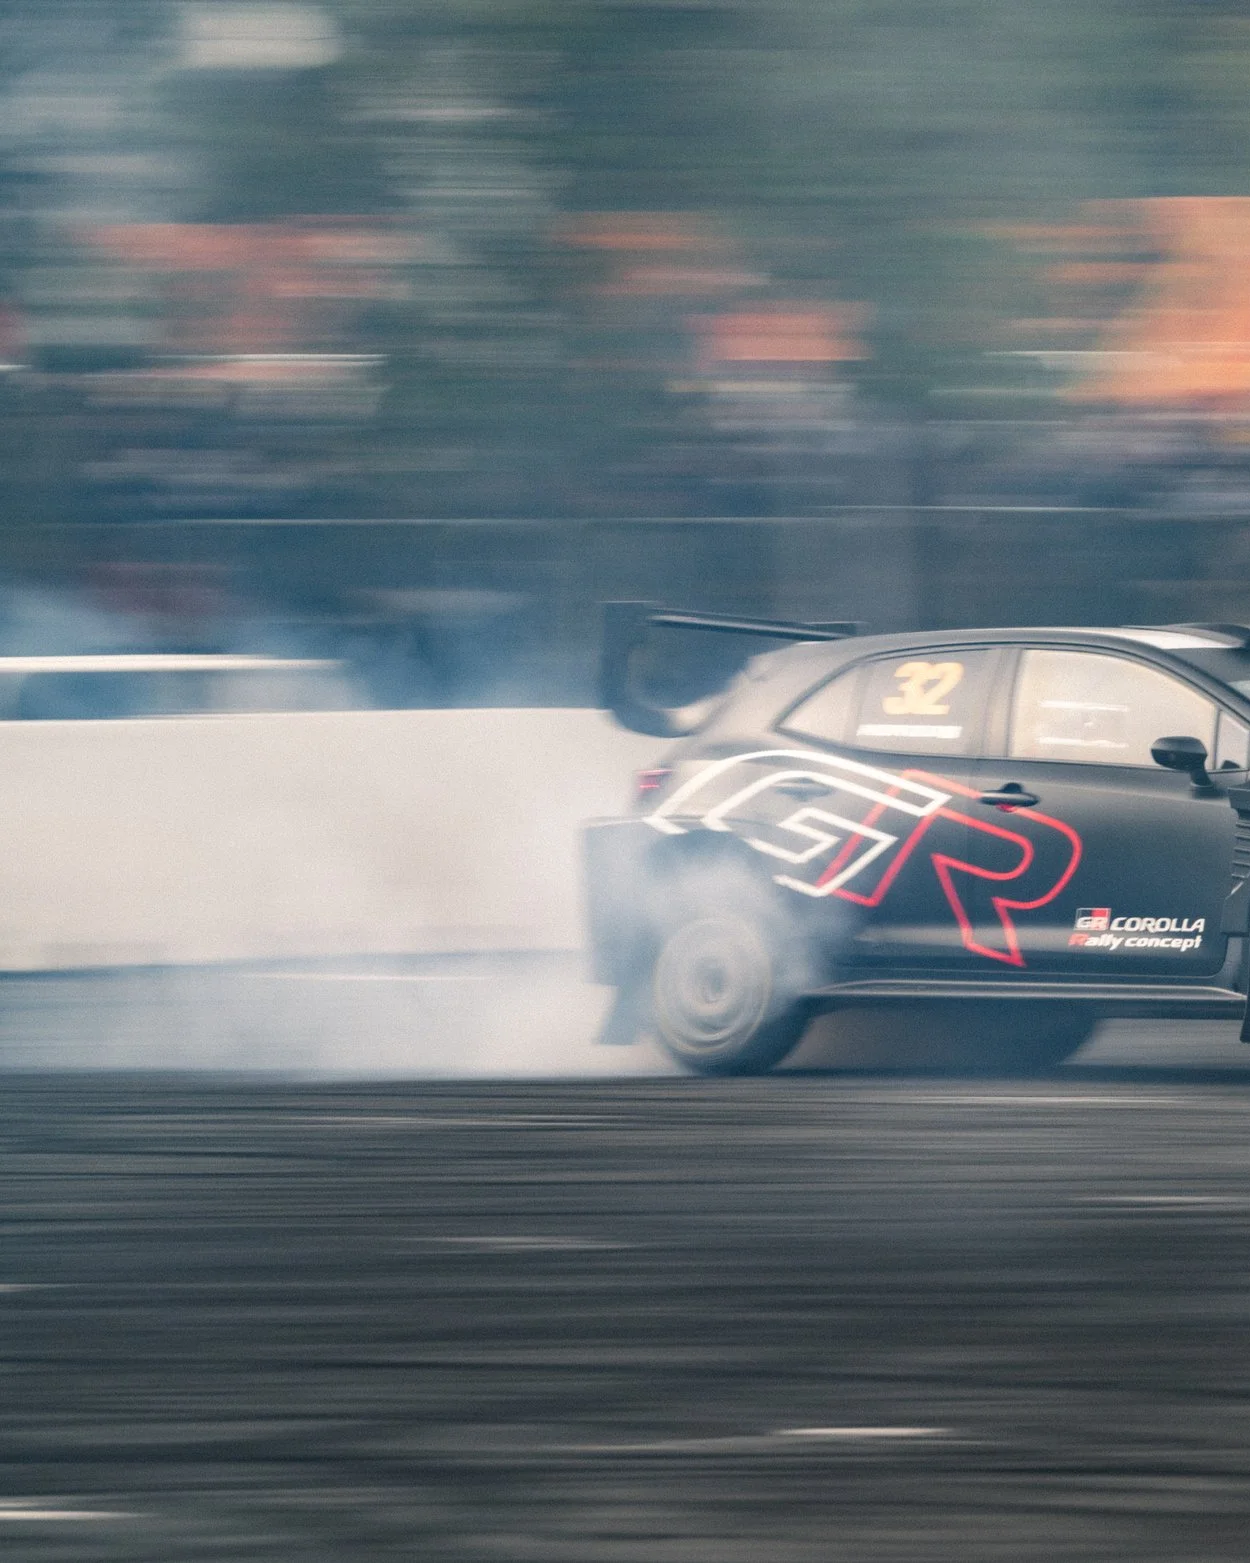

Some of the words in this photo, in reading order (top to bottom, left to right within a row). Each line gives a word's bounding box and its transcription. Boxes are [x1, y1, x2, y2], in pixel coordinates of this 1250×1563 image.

[882, 661, 965, 715] 32
[1075, 915, 1110, 931] GR
[1110, 917, 1206, 933] COROLLA
[1068, 933, 1124, 950] Rally
[1124, 935, 1202, 952] concept
